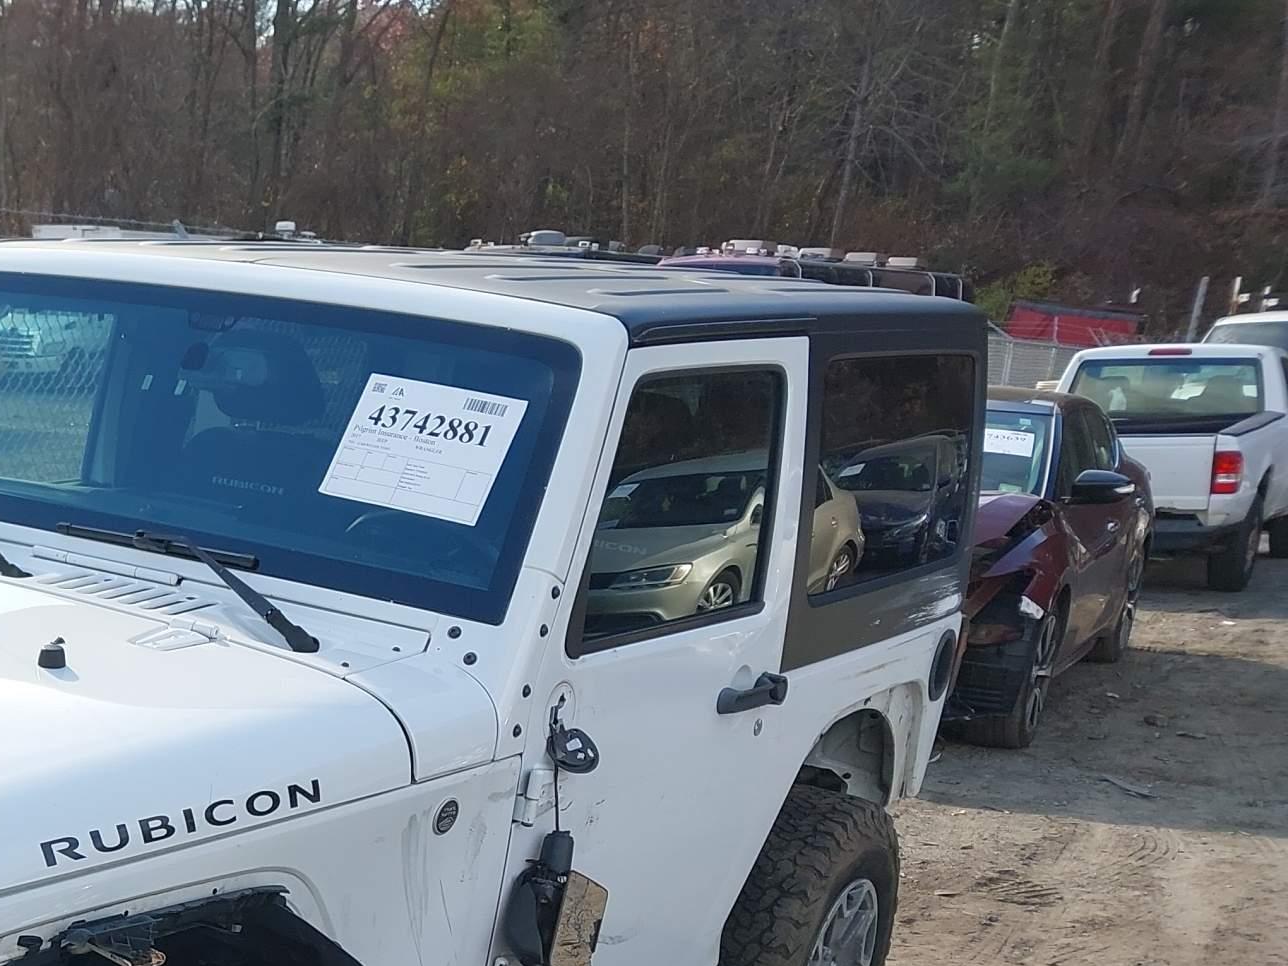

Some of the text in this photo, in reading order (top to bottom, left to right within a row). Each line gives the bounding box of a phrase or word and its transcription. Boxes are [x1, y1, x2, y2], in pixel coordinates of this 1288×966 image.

[368, 404, 492, 447] 43742881
[378, 428, 408, 440] Insurance
[39, 779, 321, 867] RUBICON
